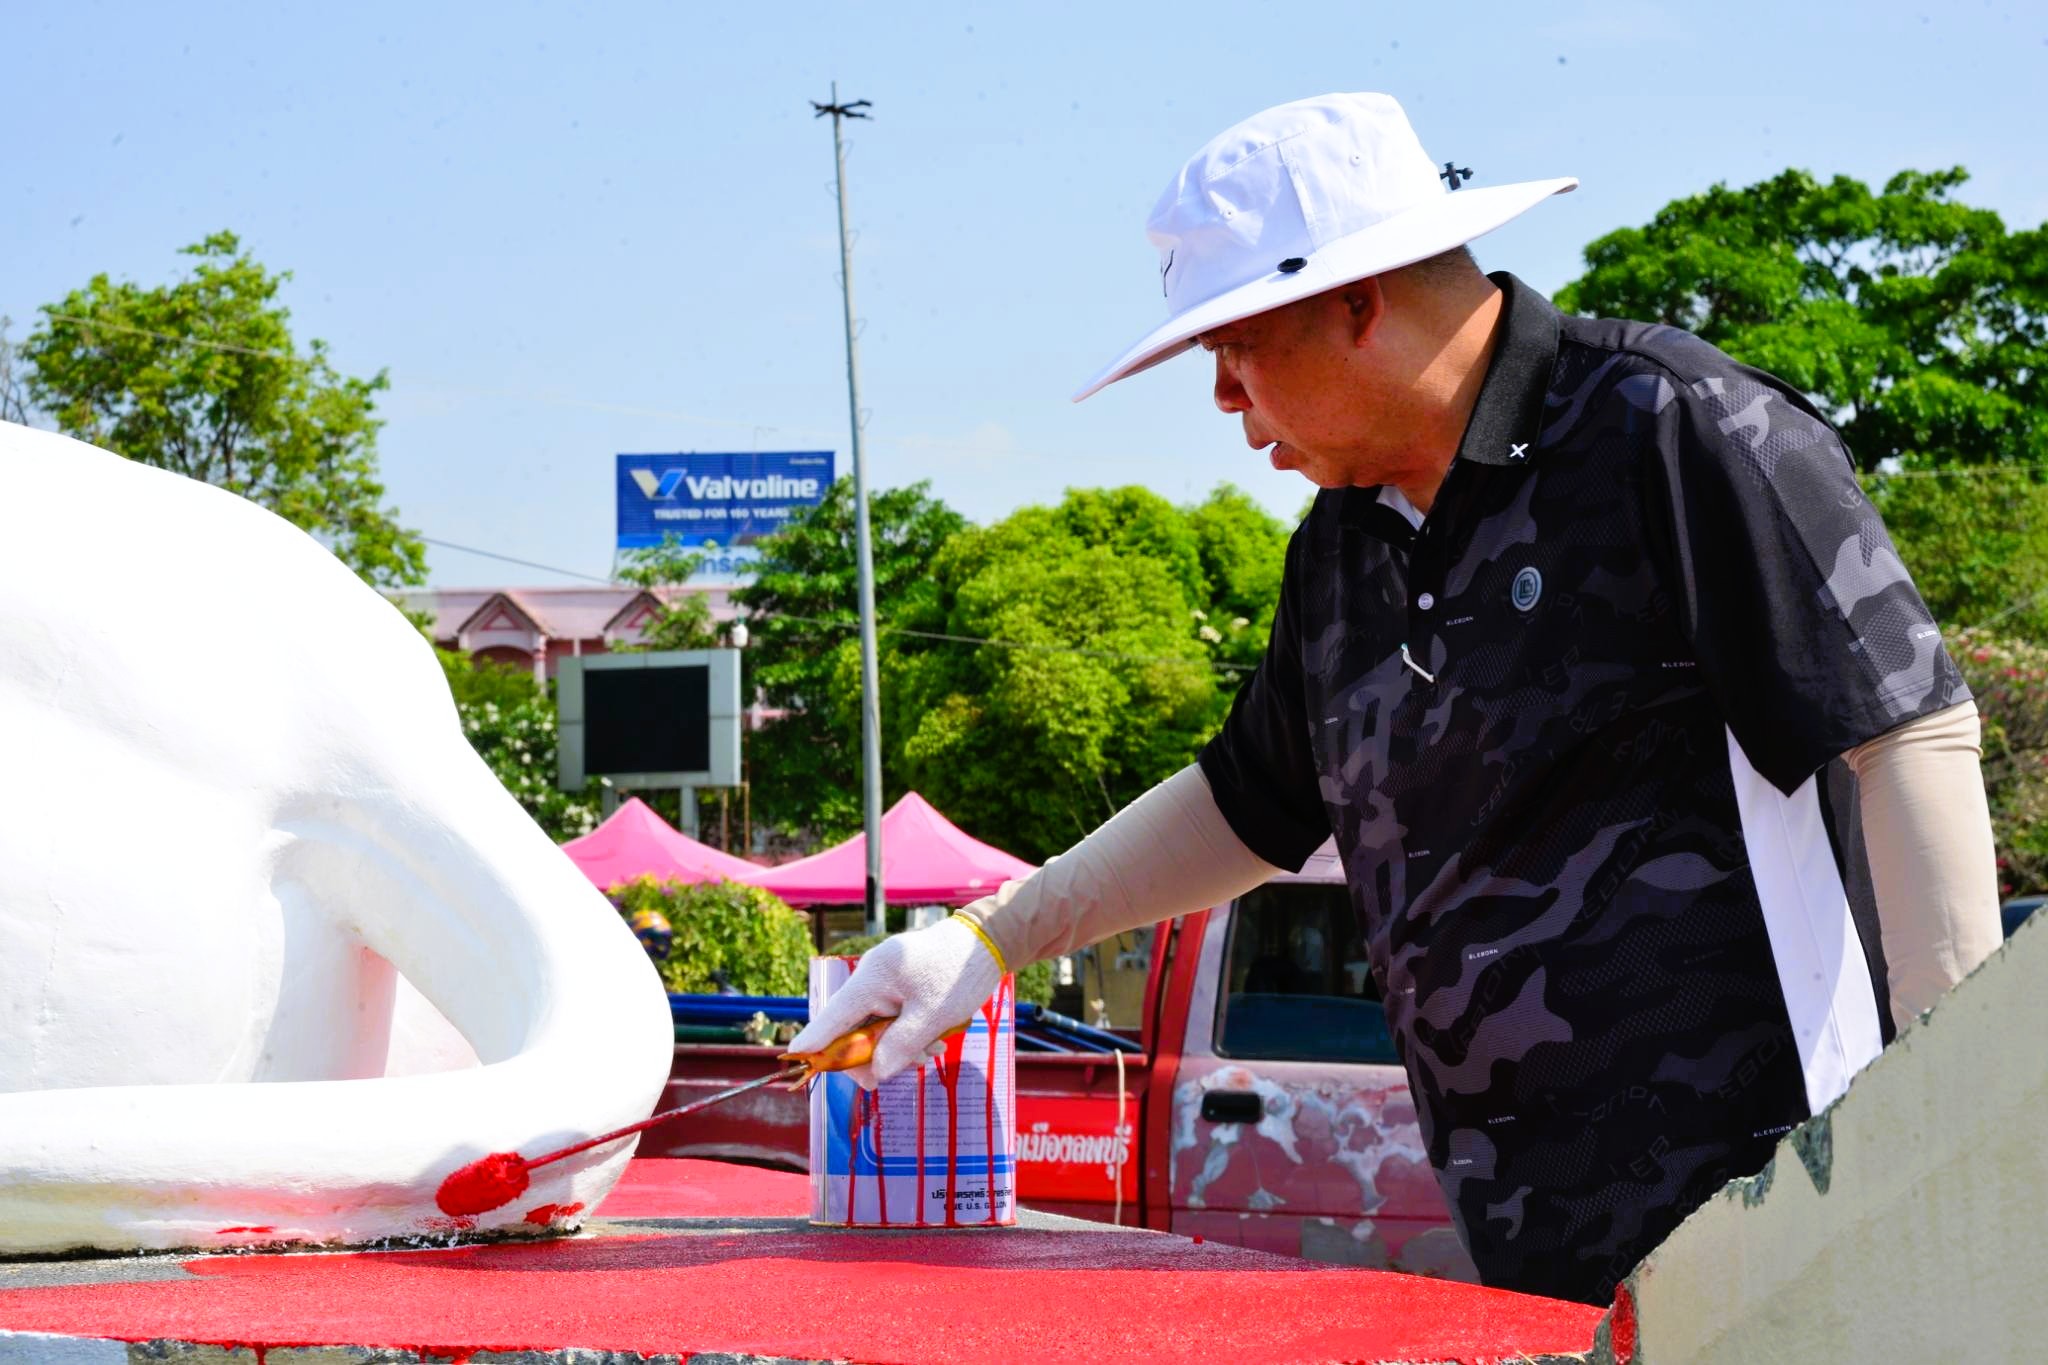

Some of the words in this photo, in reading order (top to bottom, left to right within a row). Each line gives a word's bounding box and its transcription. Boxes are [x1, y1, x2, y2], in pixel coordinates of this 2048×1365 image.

[685, 475, 819, 500] Valvoline
[654, 508, 702, 520] TRUSTED
[704, 507, 728, 519] FOR
